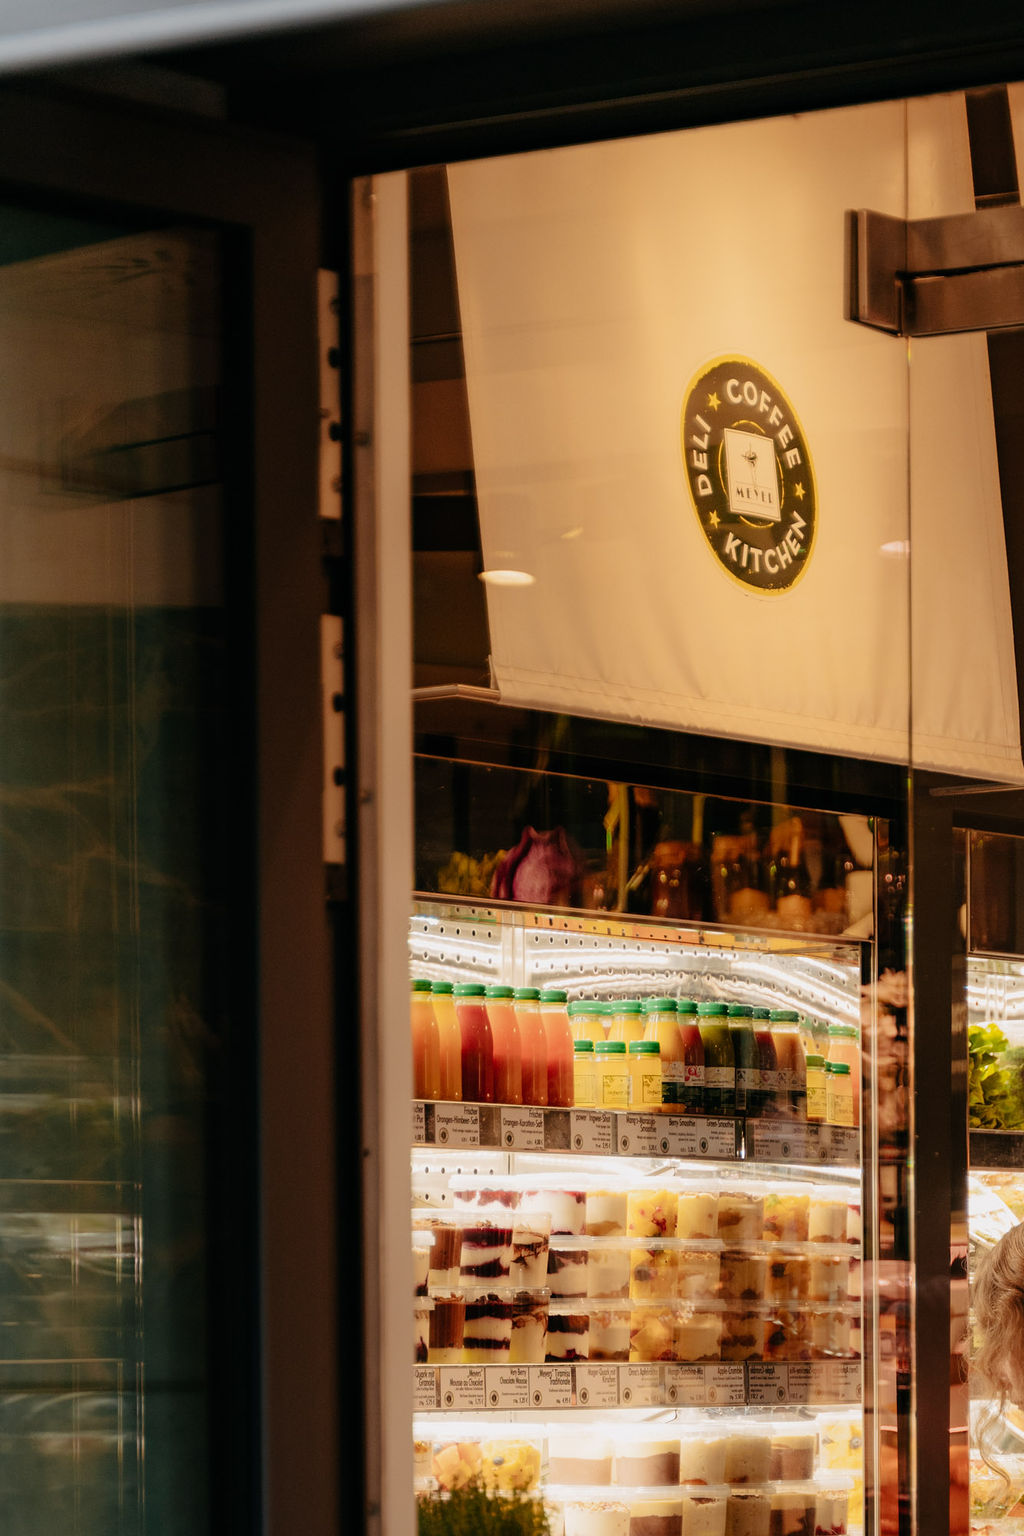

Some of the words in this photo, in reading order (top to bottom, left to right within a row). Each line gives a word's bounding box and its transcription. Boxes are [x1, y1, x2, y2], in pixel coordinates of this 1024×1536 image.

[692, 413, 714, 498] DELI
[725, 377, 803, 470] COFFEE
[724, 510, 808, 575] KITCHEN
